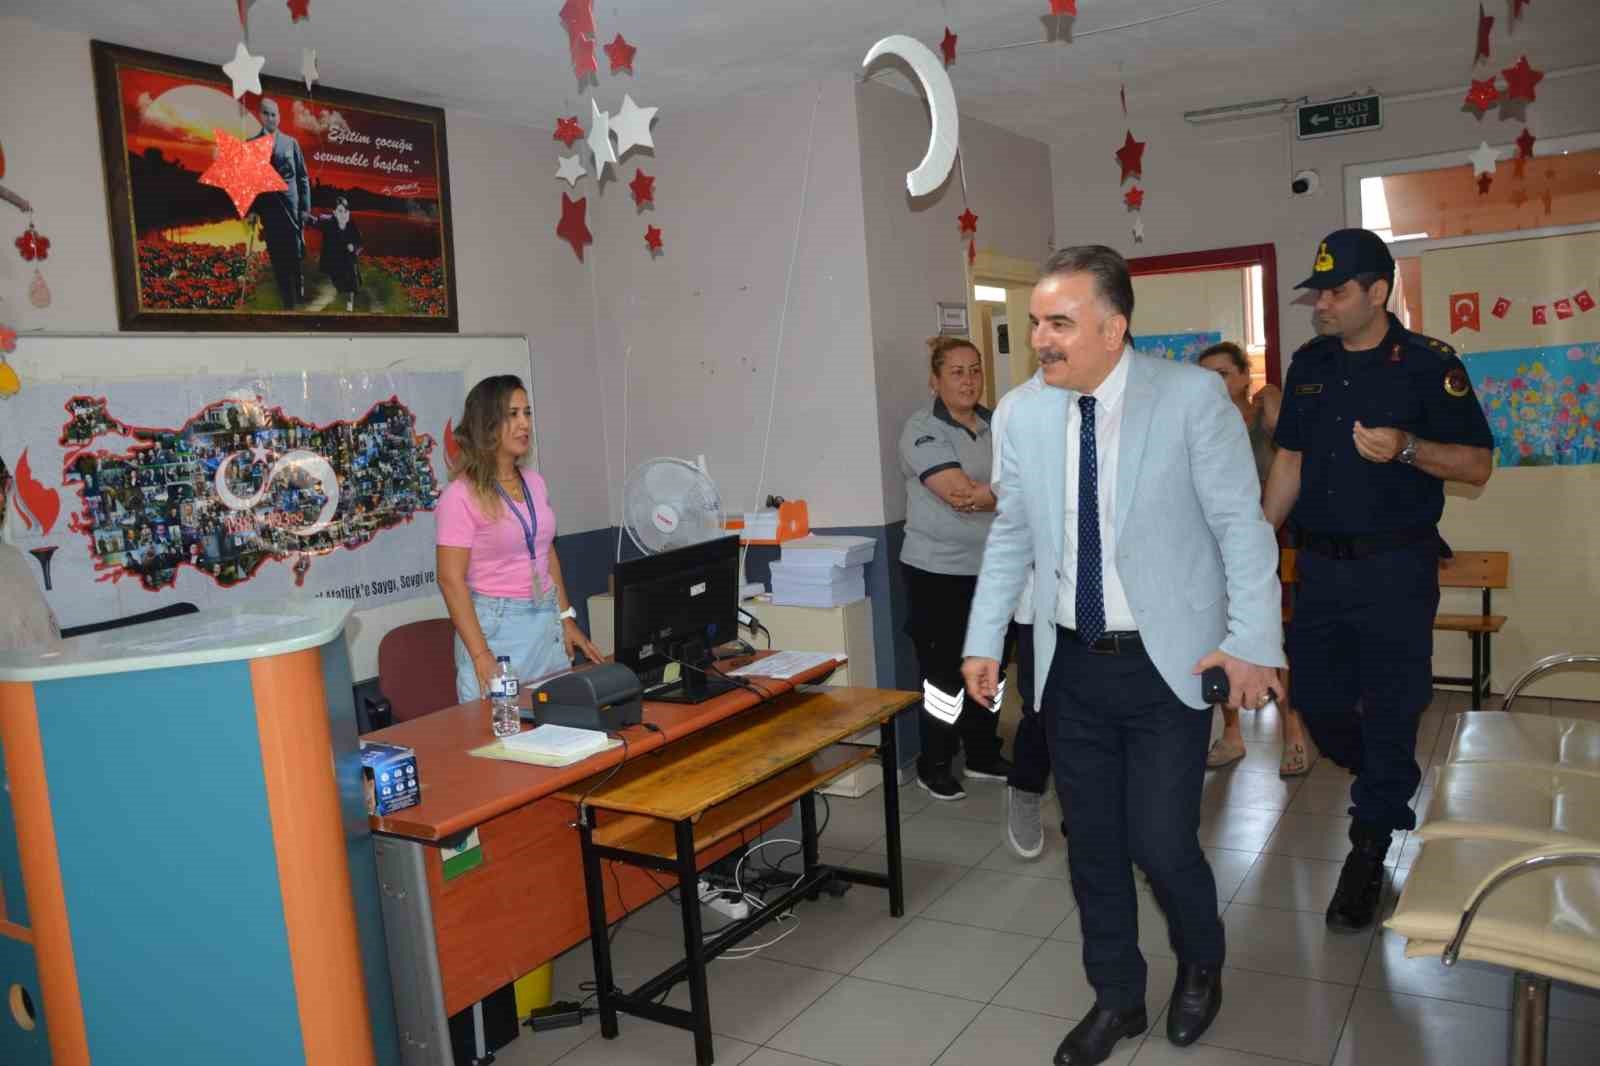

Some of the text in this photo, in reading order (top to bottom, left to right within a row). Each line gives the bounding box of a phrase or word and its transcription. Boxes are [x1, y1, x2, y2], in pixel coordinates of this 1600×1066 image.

[1334, 113, 1369, 129] EXIT
[375, 136, 414, 154] çocuğu
[313, 151, 370, 168] sevmekle
[400, 572, 424, 589] Sevgi
[425, 571, 435, 583] ve
